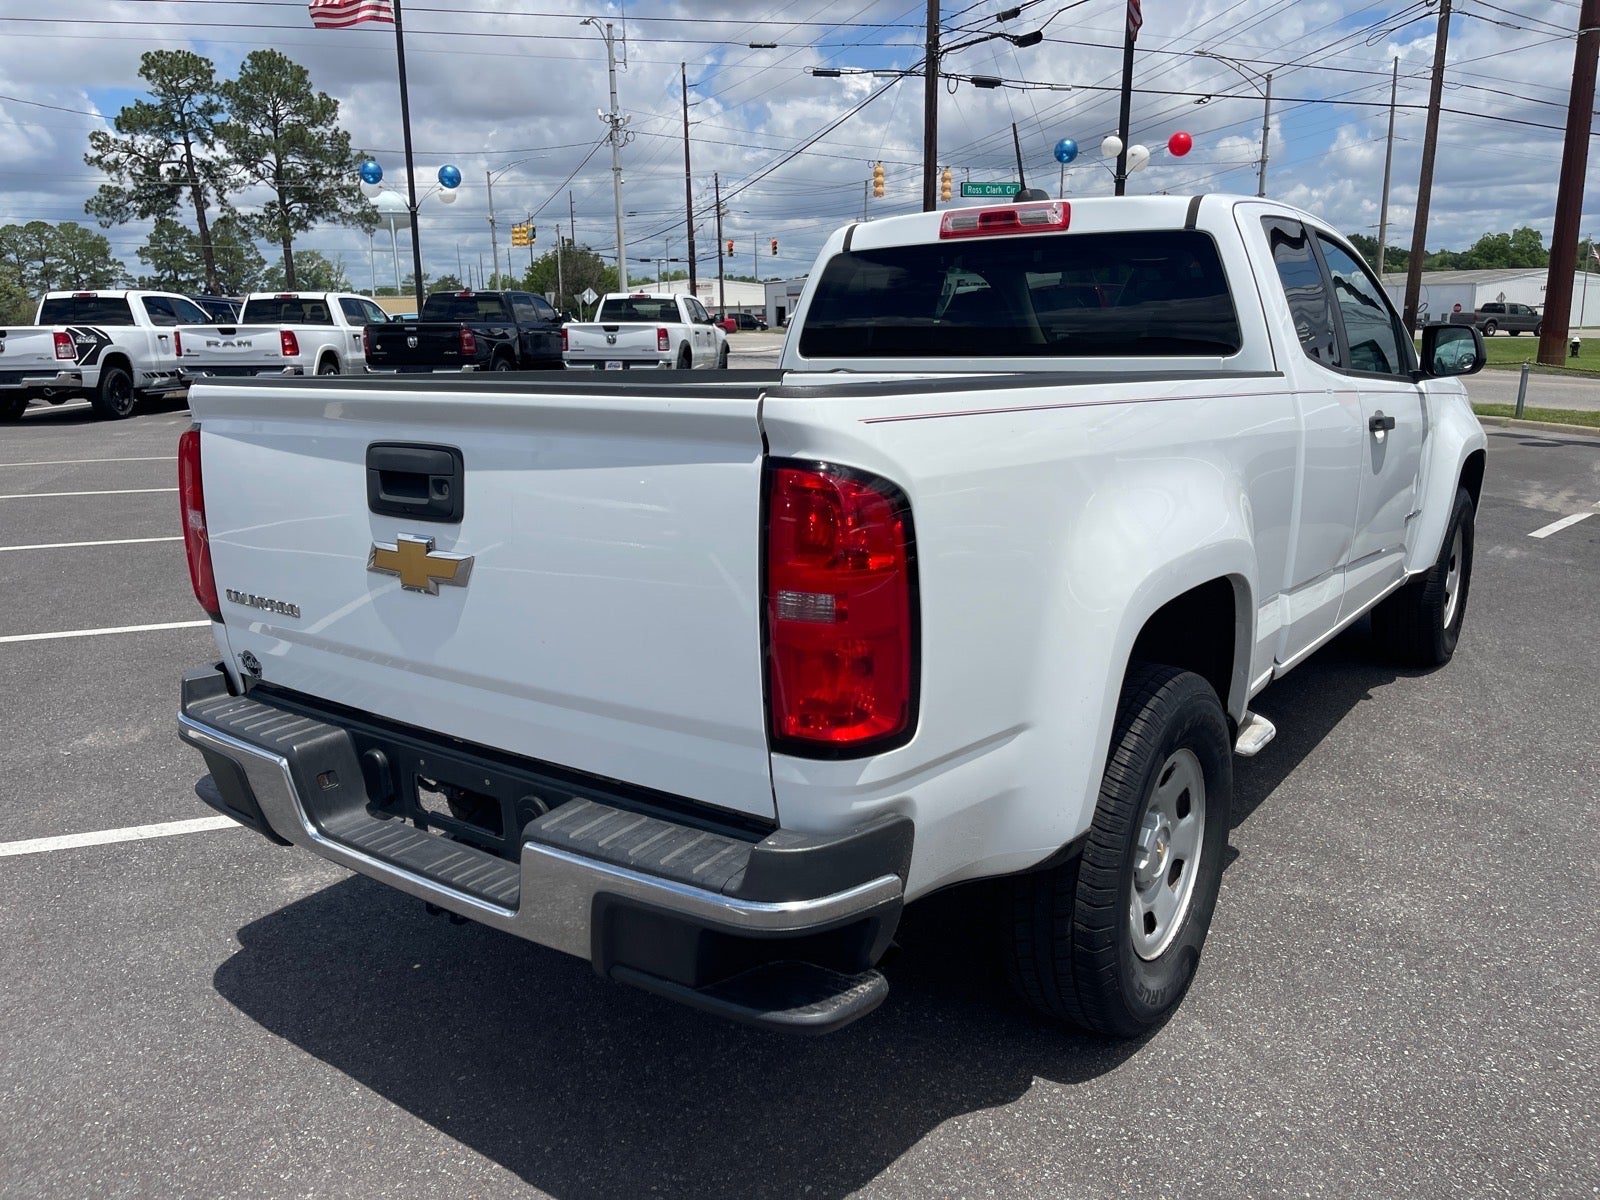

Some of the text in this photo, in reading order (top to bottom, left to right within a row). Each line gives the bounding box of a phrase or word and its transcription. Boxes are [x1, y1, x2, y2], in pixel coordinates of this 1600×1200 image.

[967, 185, 1016, 194] Ross Clark Cir
[206, 340, 253, 348] RAM
